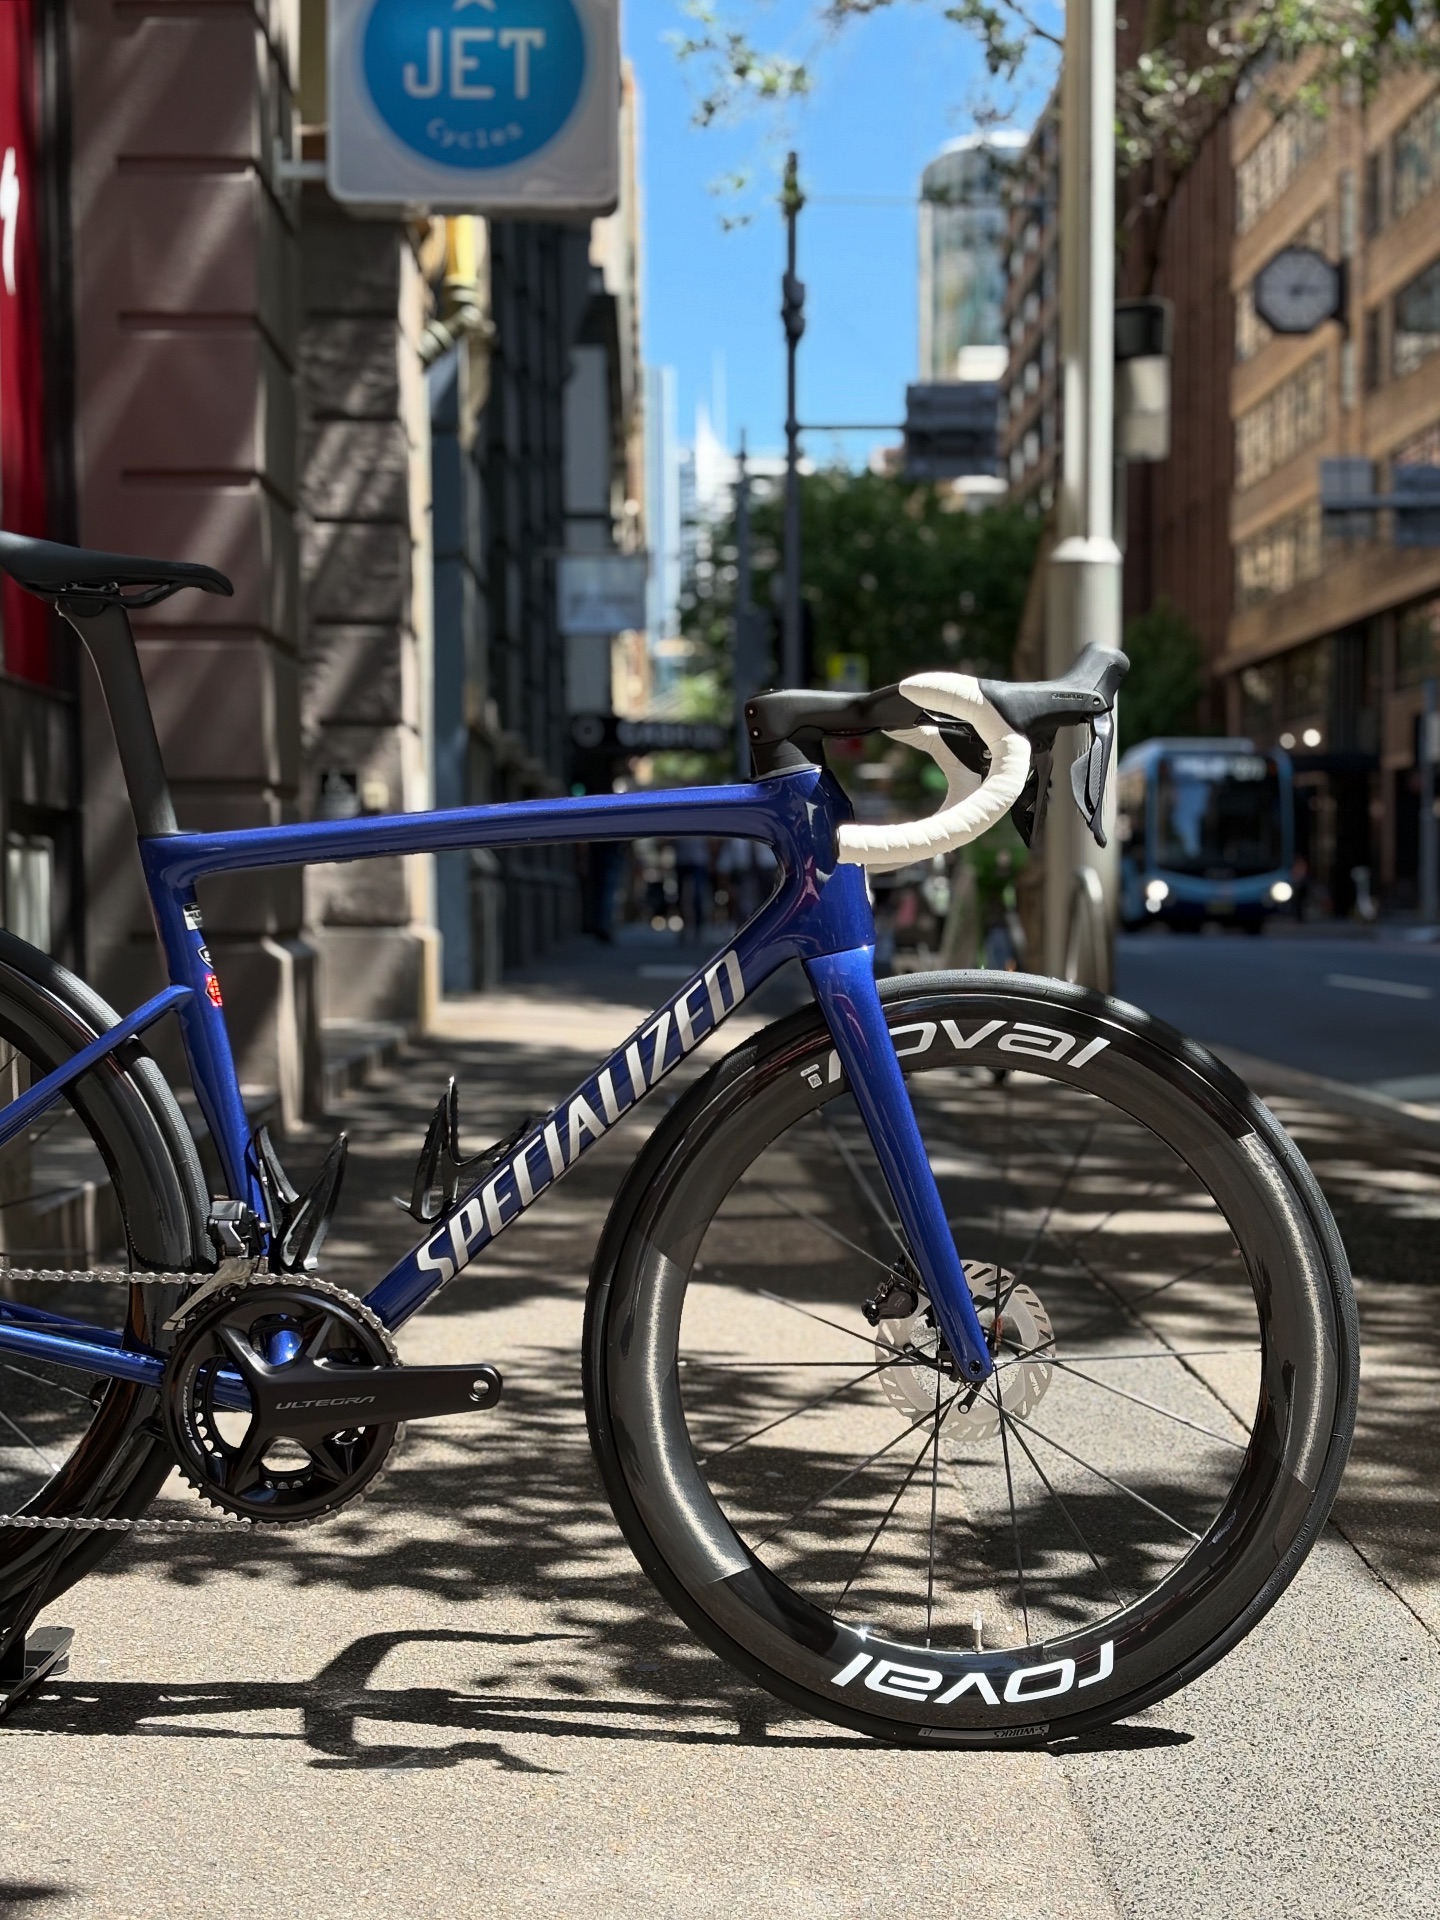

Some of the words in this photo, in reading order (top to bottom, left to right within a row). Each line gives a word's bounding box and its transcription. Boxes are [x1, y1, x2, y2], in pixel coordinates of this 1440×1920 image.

[403, 27, 545, 100] JET
[426, 117, 523, 149] Cycles
[416, 950, 745, 1284] SPECIALIZED
[183, 1385, 194, 1438] ULTEGRA
[275, 1396, 376, 1411] ULTEGRA
[831, 1640, 1114, 1705] roval
[993, 1724, 1048, 1737] S-WORKS
